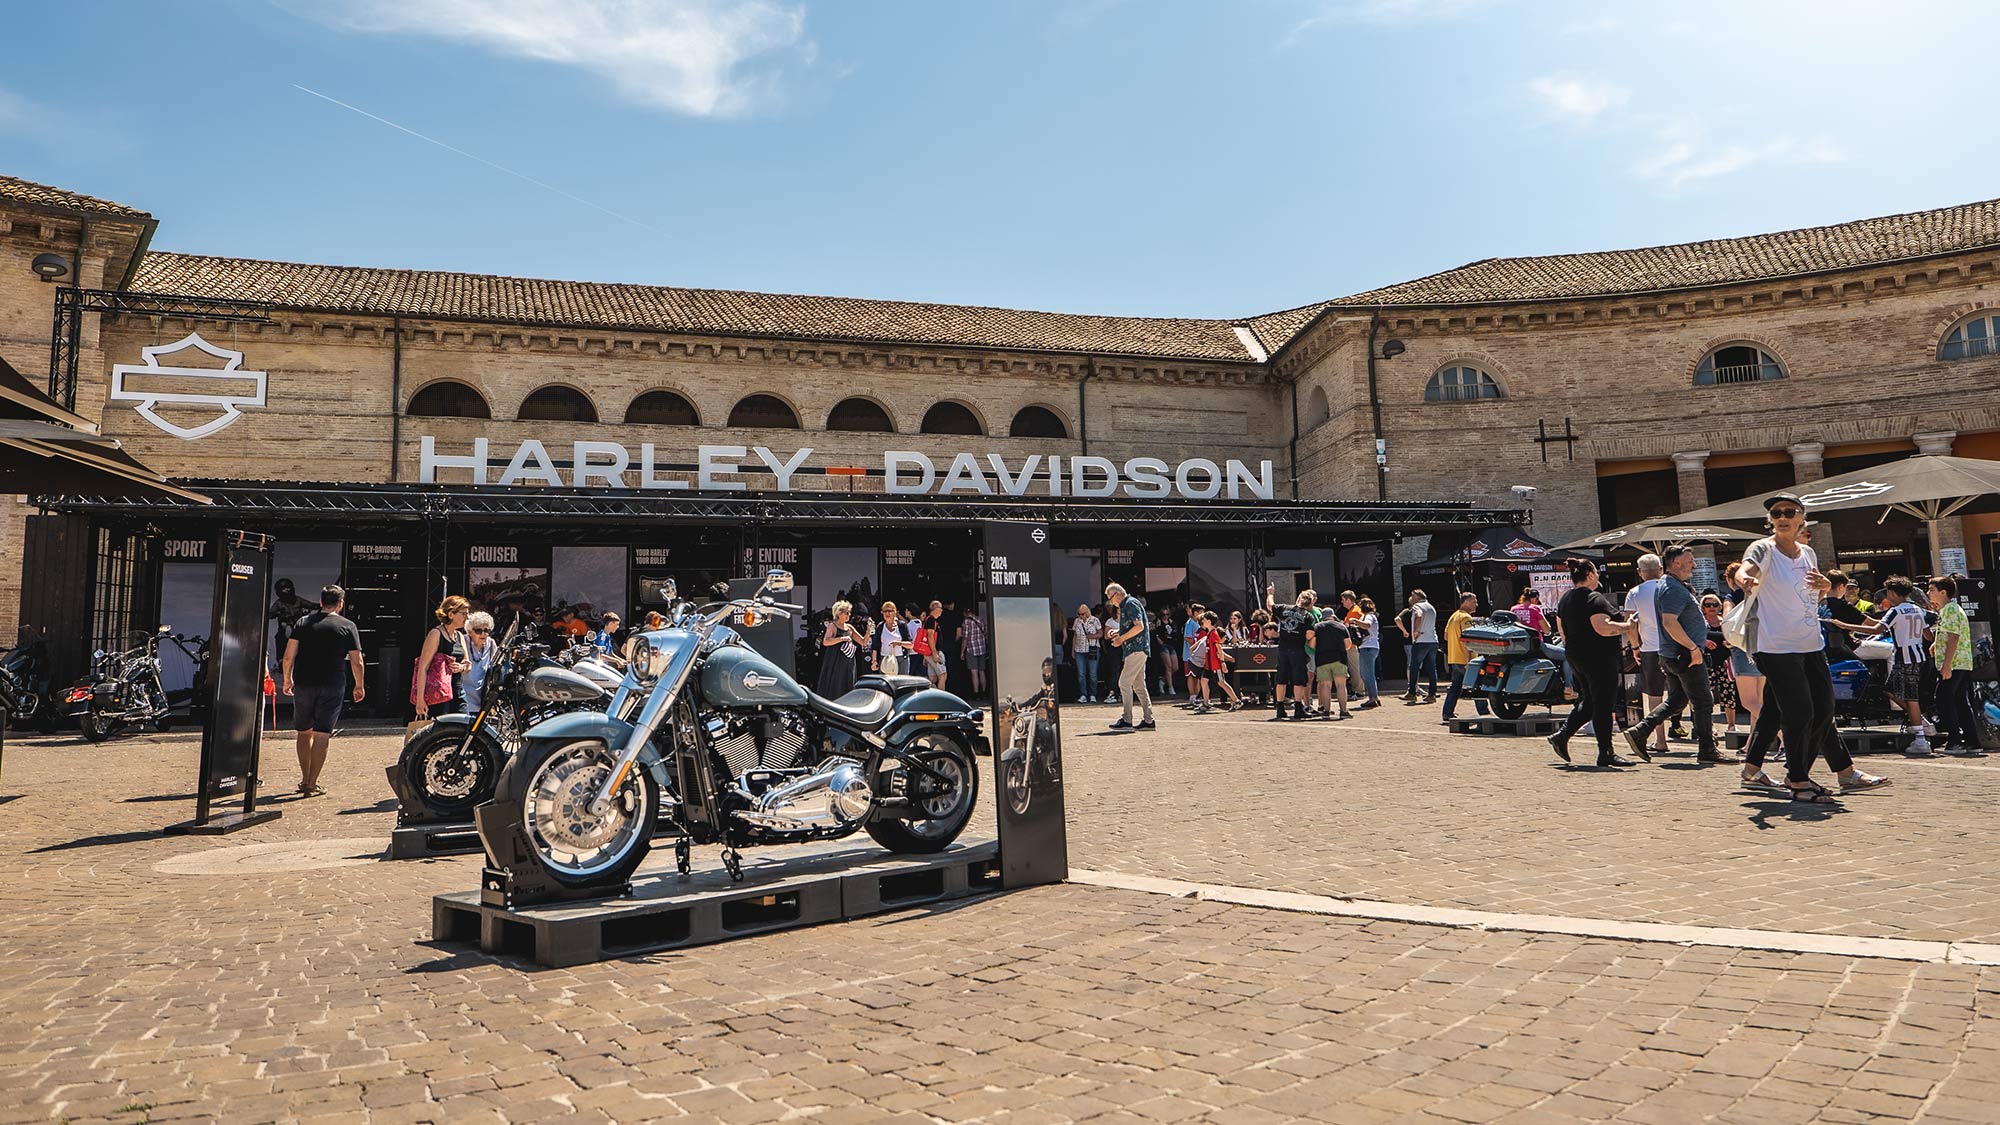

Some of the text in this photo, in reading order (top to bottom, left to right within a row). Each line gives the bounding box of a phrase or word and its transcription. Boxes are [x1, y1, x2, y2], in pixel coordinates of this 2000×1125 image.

[164, 540, 206, 557] SPORT
[352, 545, 402, 555] HARLEY-DAVIDSON
[470, 545, 518, 563] CRUISER
[635, 548, 670, 557] YOUR HARLEY
[885, 549, 897, 557] YOUR
[635, 556, 666, 565] YOUR RULES
[991, 556, 1007, 570] 2024
[231, 563, 254, 575] CRUISER
[991, 571, 1003, 585] FAT
[1019, 572, 1030, 585] 114
[734, 606, 746, 614] 202
[1905, 614, 1923, 639] 10
